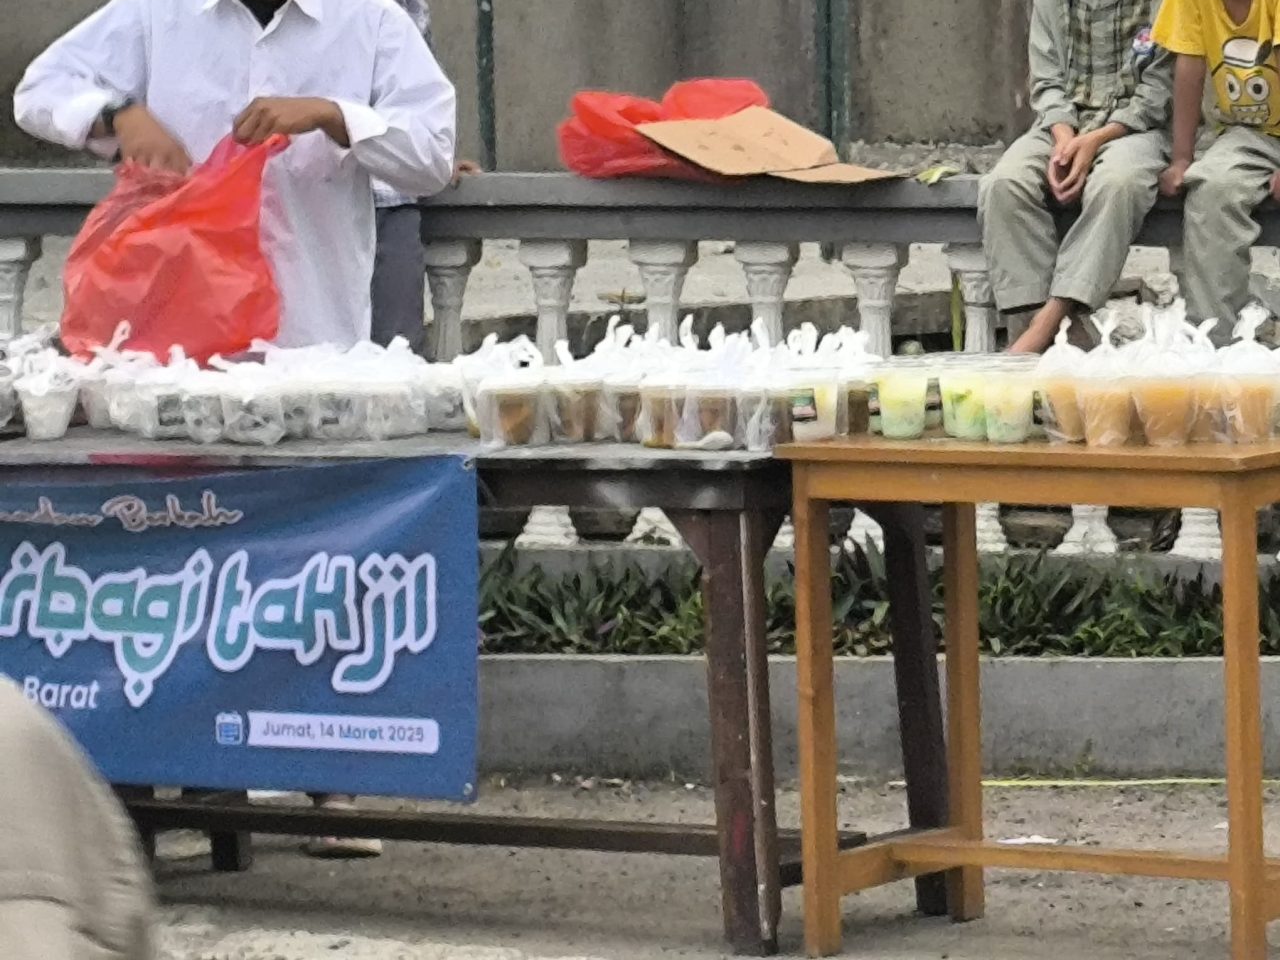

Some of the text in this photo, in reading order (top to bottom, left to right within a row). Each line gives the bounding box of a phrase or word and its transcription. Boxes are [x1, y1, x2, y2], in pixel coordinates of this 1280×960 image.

[23, 675, 99, 710] Barat
[262, 720, 315, 740] Jumat,
[319, 721, 335, 737] 14
[338, 723, 385, 741] Maret
